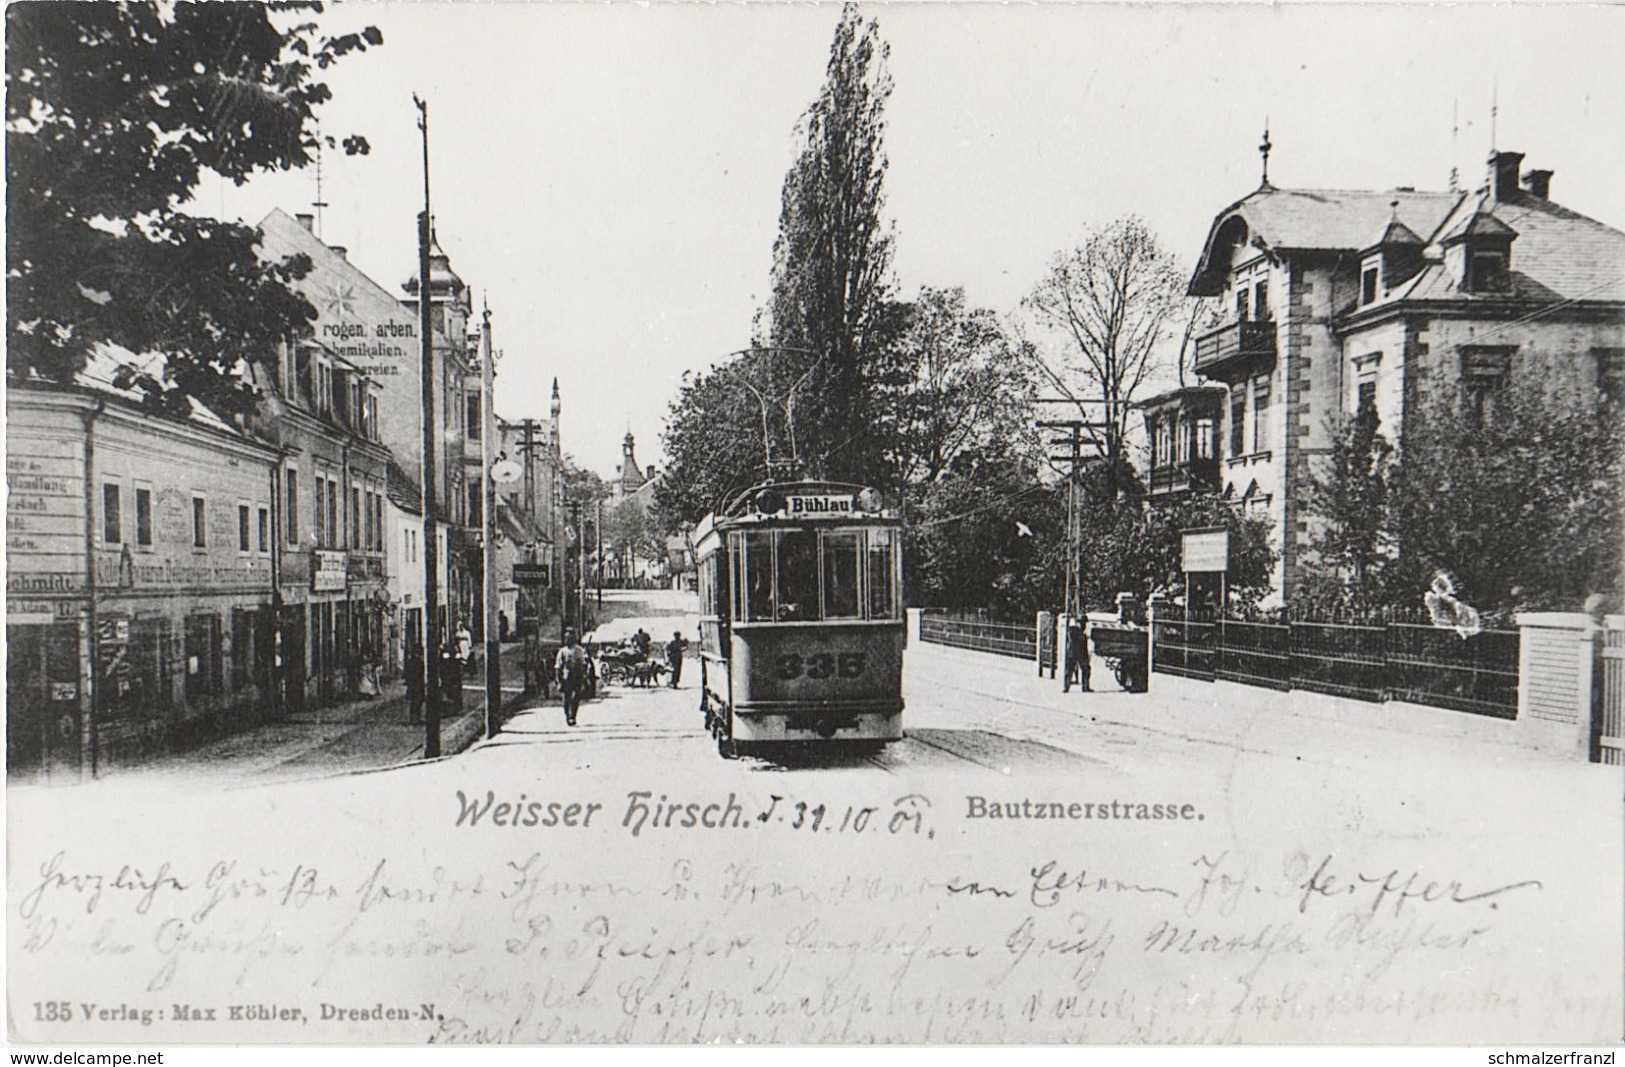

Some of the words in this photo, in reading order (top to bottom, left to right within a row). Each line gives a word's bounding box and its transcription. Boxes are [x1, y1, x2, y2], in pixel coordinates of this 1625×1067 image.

[791, 497, 850, 513] Bühlau
[456, 791, 602, 827] Weisser
[623, 792, 749, 836] Hirsch.
[966, 796, 1204, 820] Bautznerstrasse.
[33, 1002, 72, 1021] 135
[81, 1003, 165, 1025] Verlag:
[173, 1005, 215, 1020] Max
[321, 1004, 444, 1026] Dresden-N.
